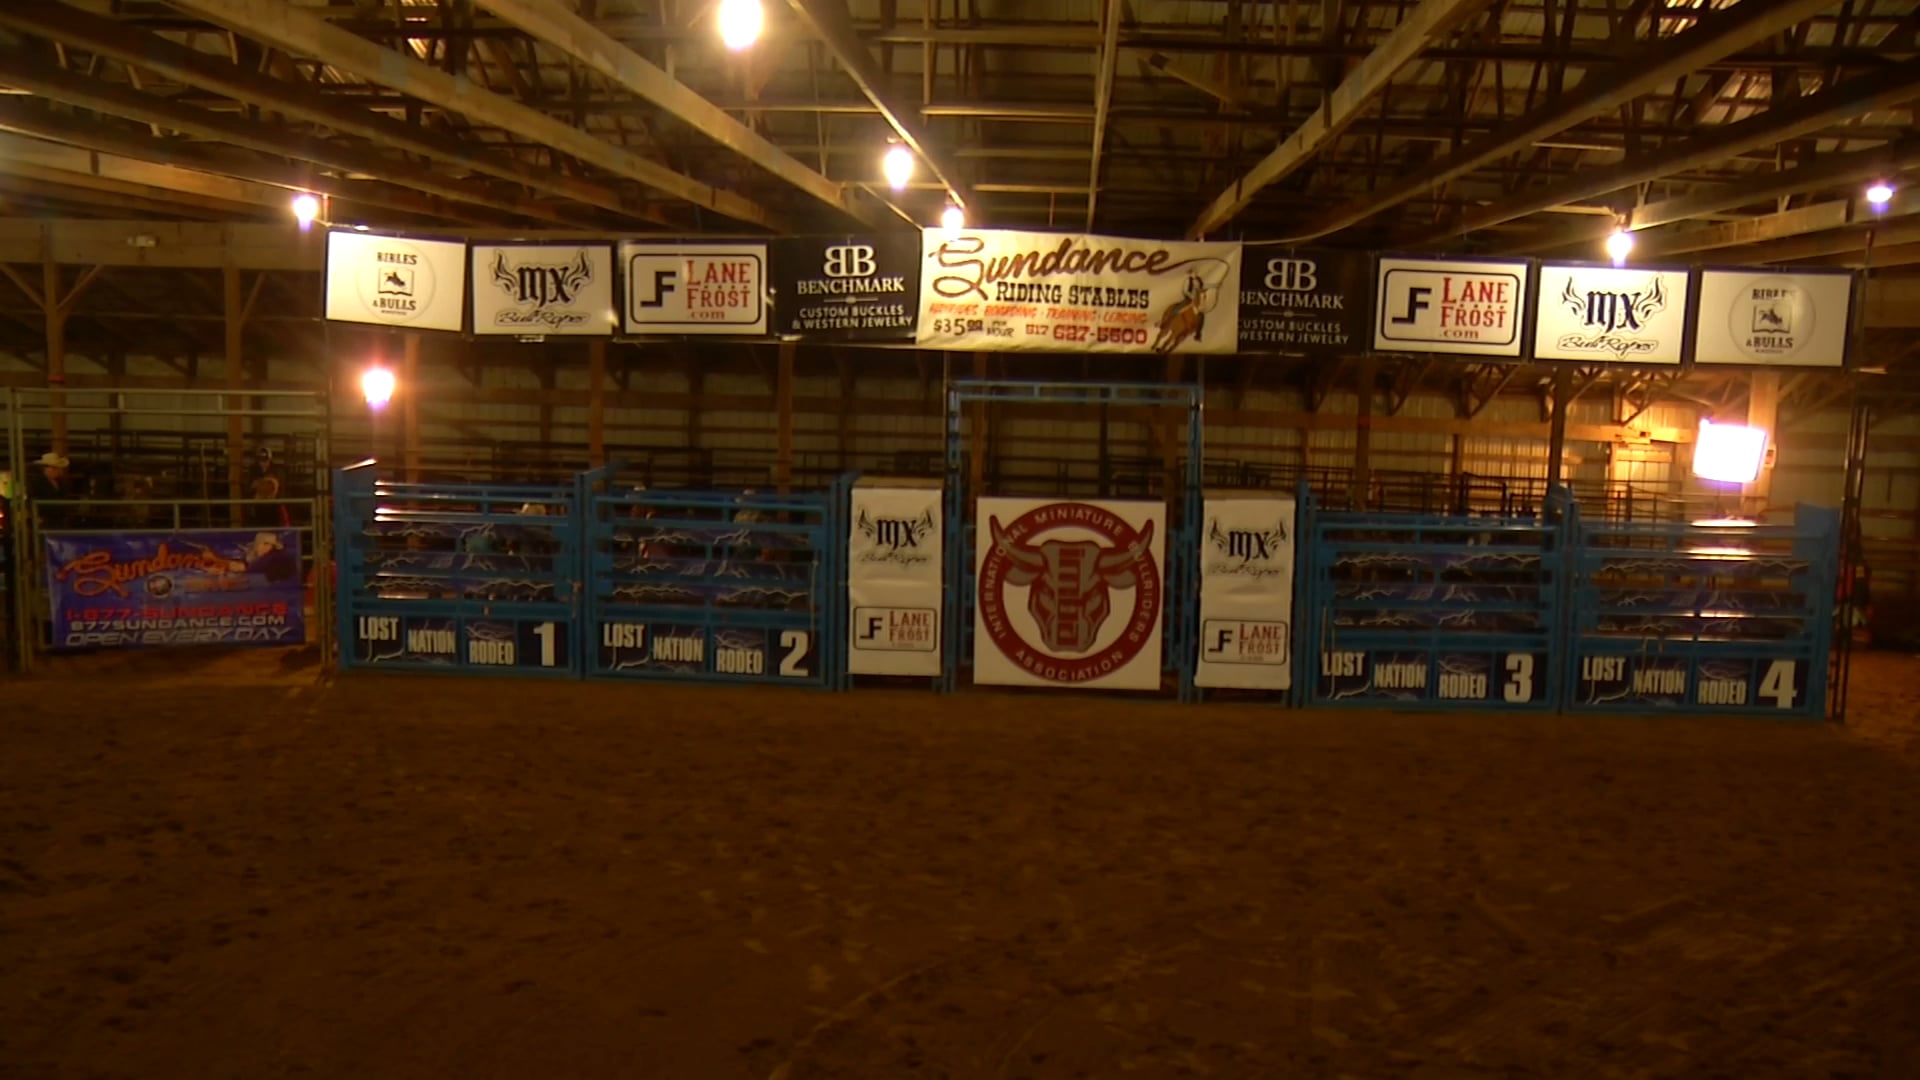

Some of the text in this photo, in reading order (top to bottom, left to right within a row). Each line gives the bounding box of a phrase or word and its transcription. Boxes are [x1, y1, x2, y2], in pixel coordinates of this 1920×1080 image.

[686, 260, 751, 285] LANE
[928, 236, 1172, 301] Sundance
[797, 277, 905, 295] BENCHMARK
[995, 281, 1149, 308] RIDING STABLES
[1442, 276, 1509, 304] LANE
[380, 297, 416, 311] BULLS
[686, 287, 751, 309] FROST
[800, 304, 904, 319] CUSTOM BUCKLES
[1440, 305, 1507, 328] FROST
[792, 315, 912, 330] & WESTERN JEWELRY
[1289, 321, 1341, 333] BUCKLES
[1054, 324, 1147, 345] 627-5500
[1297, 332, 1349, 345] JEWELRY
[1753, 336, 1794, 349] BULLS
[1034, 507, 1124, 537] MINIATURE
[56, 541, 230, 598] Sundance
[70, 615, 285, 632] 877SUNDANCE.COM
[888, 610, 930, 627] LANE
[65, 626, 292, 647] OPEN EVERY DAY
[359, 616, 555, 667] LOST NATION RODEO 1
[888, 627, 929, 642] FROST
[1239, 623, 1281, 640] LANE
[603, 622, 809, 677] LOST NATION RODEO 2
[1239, 640, 1280, 655] FROST
[1015, 650, 1124, 681] ASSOCIATION
[1321, 651, 1535, 703] LOST NATION RODEO 3
[1582, 655, 1798, 710] LOST NATION RODEO 4
